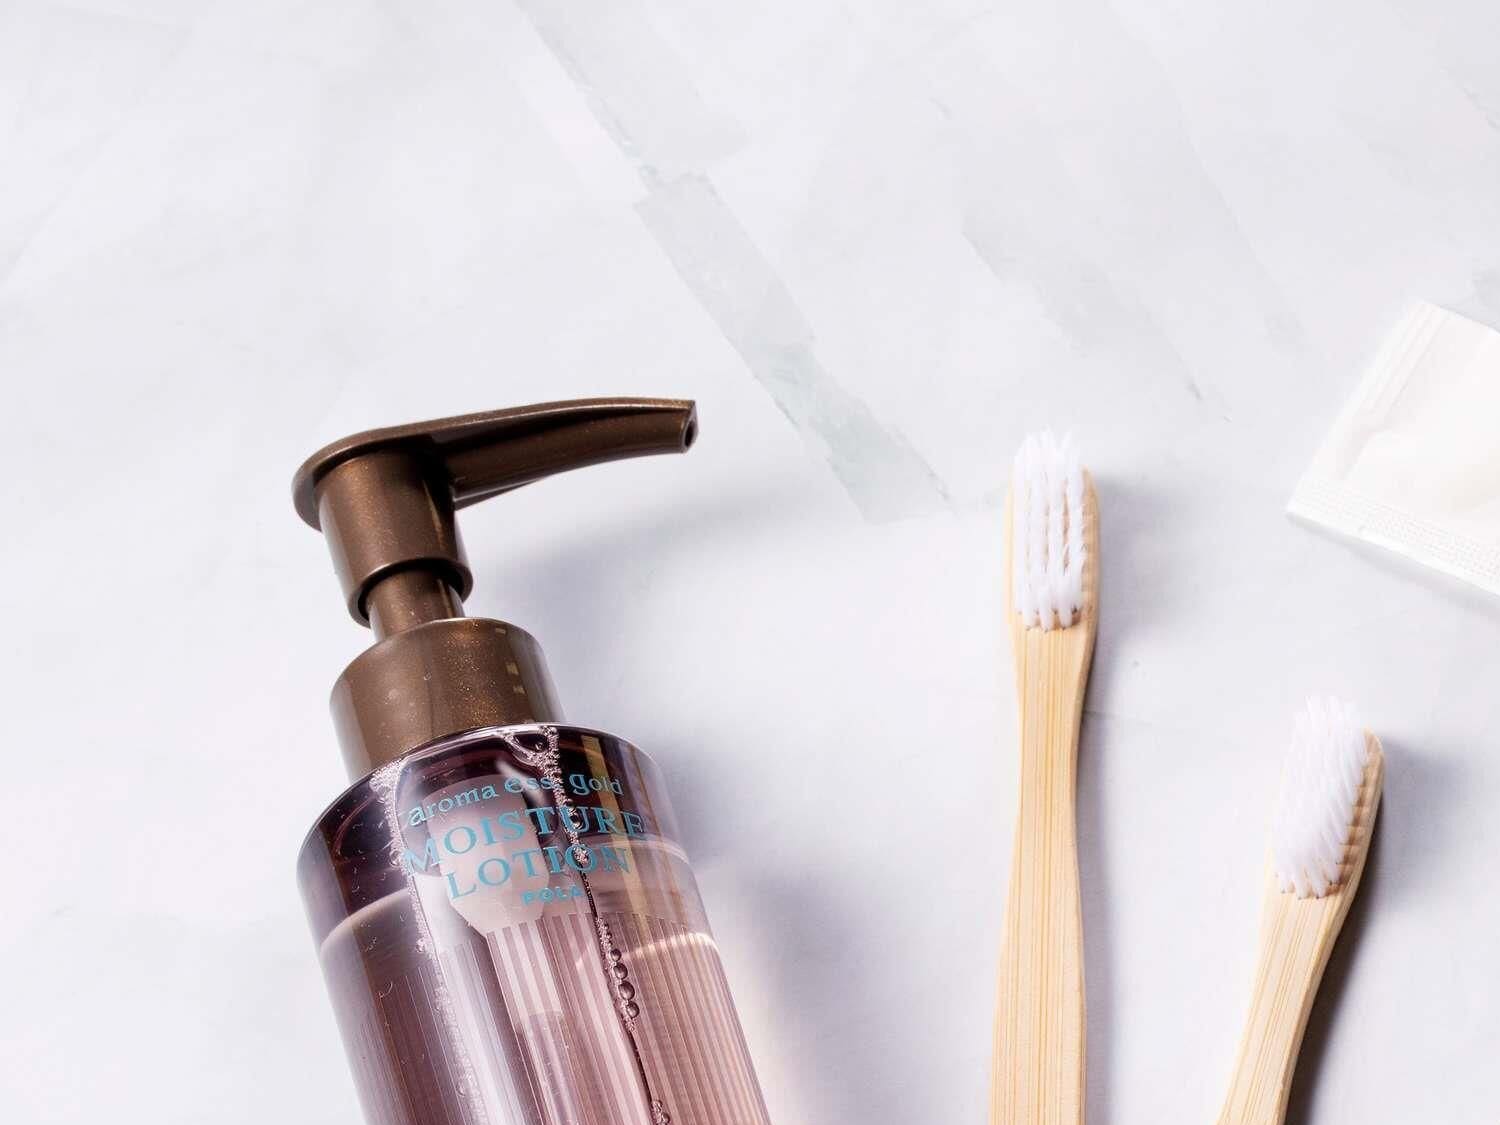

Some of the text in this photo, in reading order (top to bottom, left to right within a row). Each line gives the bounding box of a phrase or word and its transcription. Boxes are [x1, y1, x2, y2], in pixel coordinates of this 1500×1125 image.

[408, 784, 499, 827] aroma
[568, 773, 625, 796] gold
[402, 805, 646, 876] MOISTURE
[446, 843, 632, 899] LOTION
